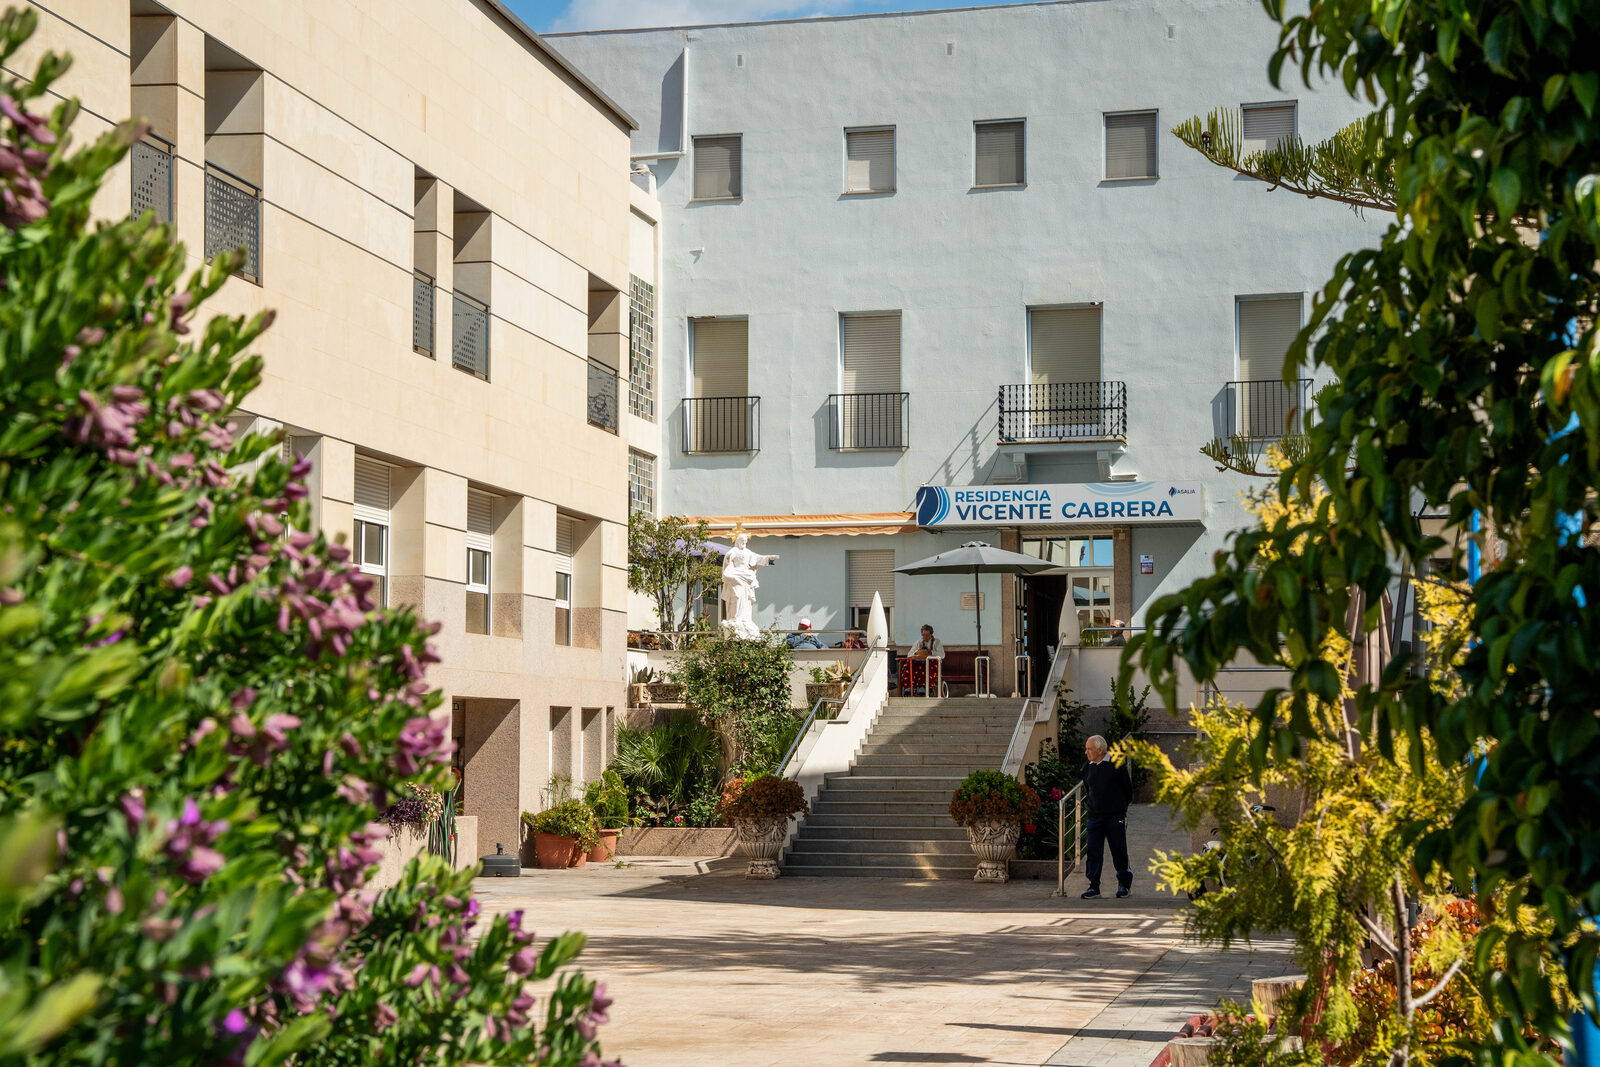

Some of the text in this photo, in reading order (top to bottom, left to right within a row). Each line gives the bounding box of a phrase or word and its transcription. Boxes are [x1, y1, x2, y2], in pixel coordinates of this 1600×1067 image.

[955, 490, 1051, 502] RESIDENCIA
[956, 501, 1173, 520] VICENTE CABRERA
